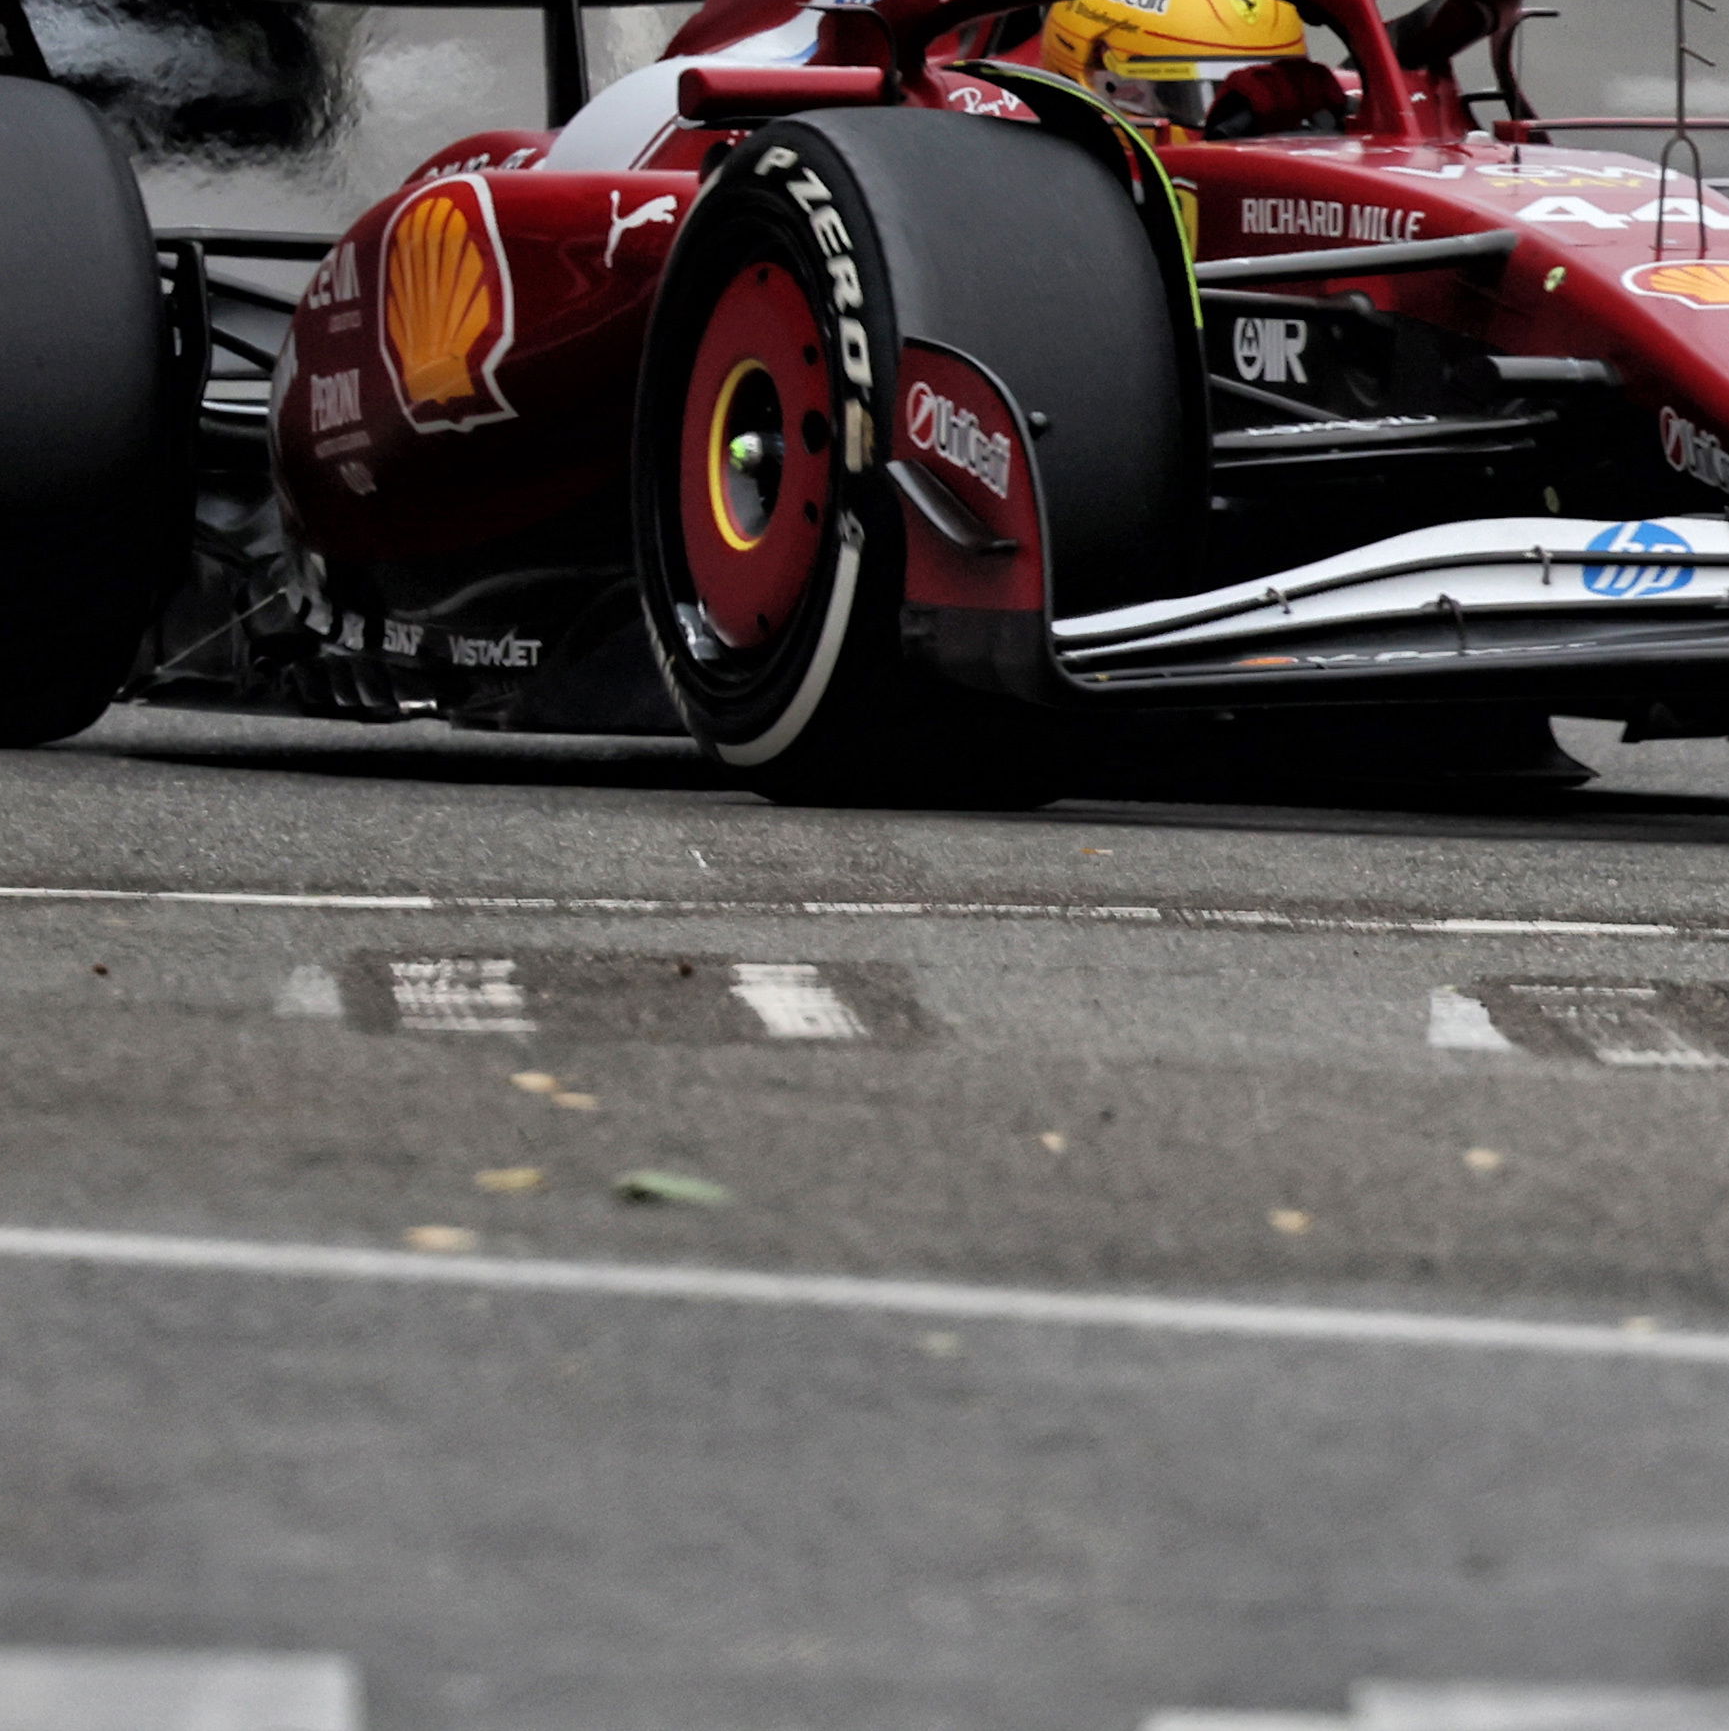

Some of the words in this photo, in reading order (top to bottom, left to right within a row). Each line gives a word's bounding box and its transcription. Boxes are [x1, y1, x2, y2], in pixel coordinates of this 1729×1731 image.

[1241, 197, 1342, 238] RICHARD
[1348, 204, 1426, 242] MILLE
[754, 145, 799, 176] P
[785, 166, 874, 388] ZERO
[382, 618, 424, 658] SKF
